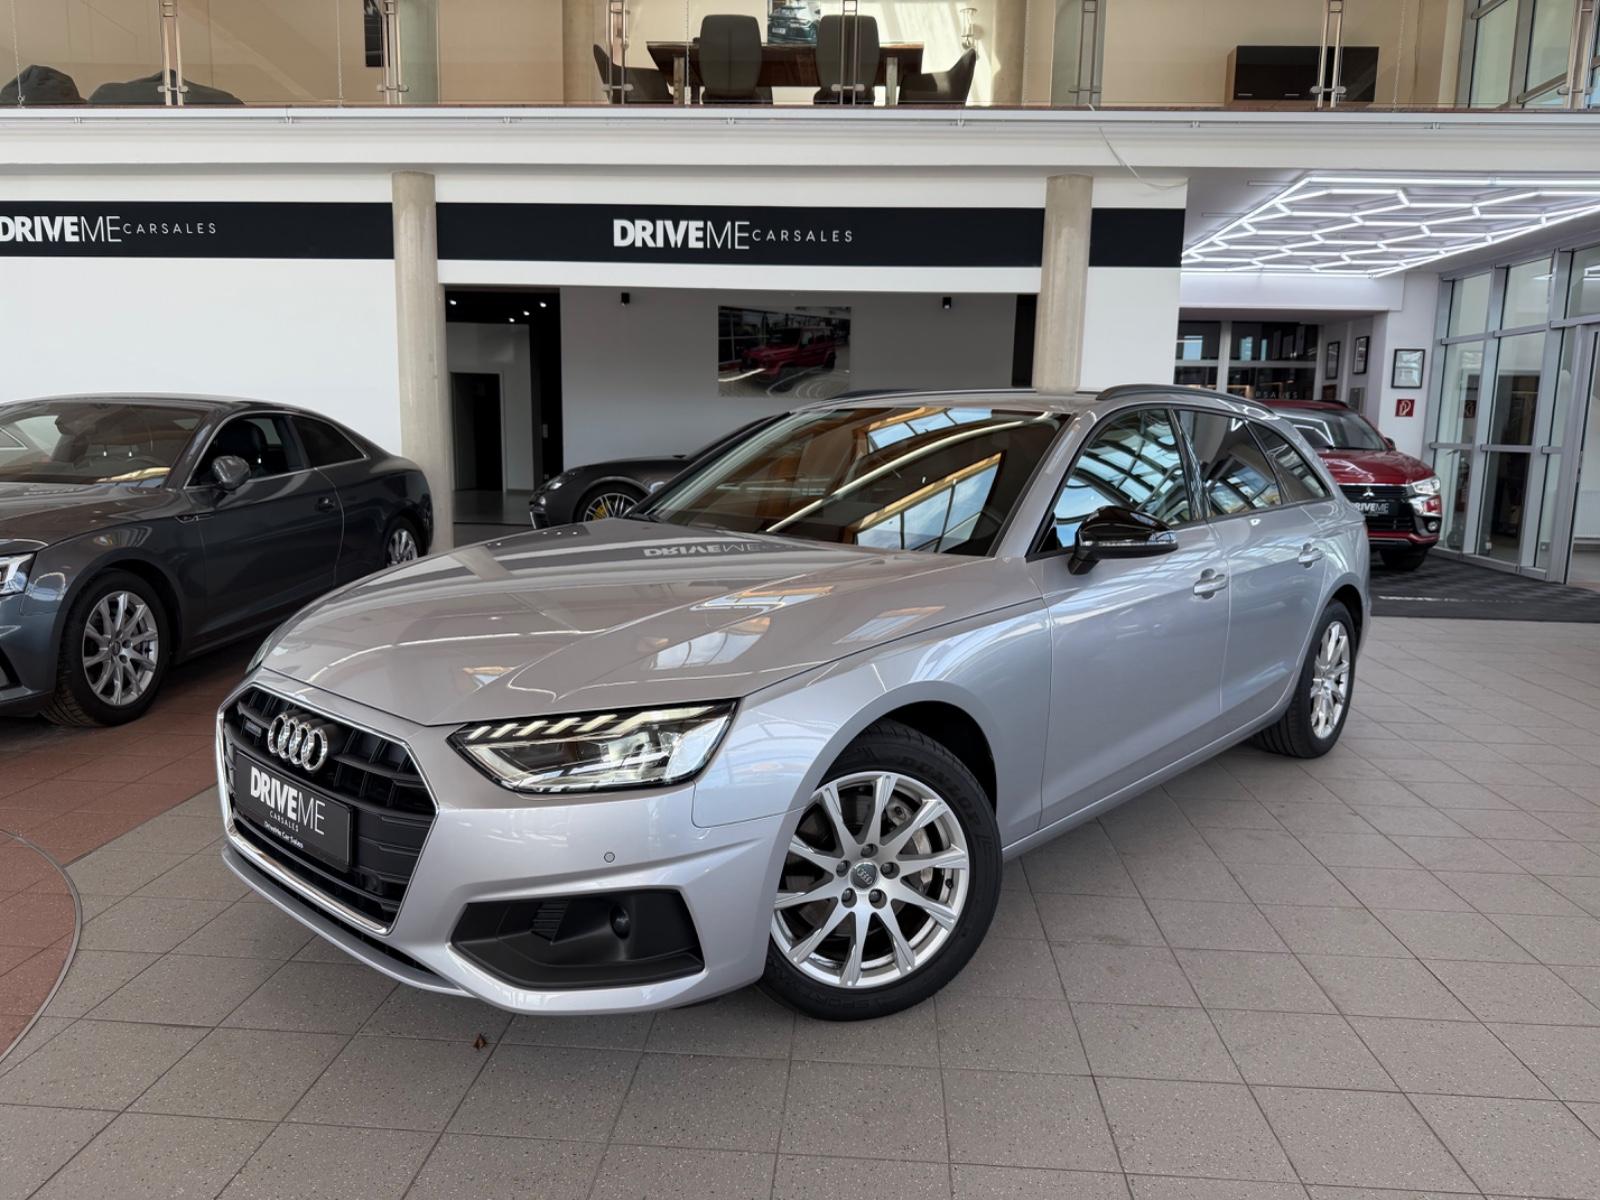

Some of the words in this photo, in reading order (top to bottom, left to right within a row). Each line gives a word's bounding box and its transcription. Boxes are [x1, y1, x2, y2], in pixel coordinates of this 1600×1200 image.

[0, 215, 122, 243] DRIVEME
[123, 222, 217, 235] CARSALES
[613, 219, 750, 250] DRIVEME
[752, 229, 854, 243] CARSALES
[250, 766, 326, 836] DRIVEME
[269, 810, 299, 832] CARSALES
